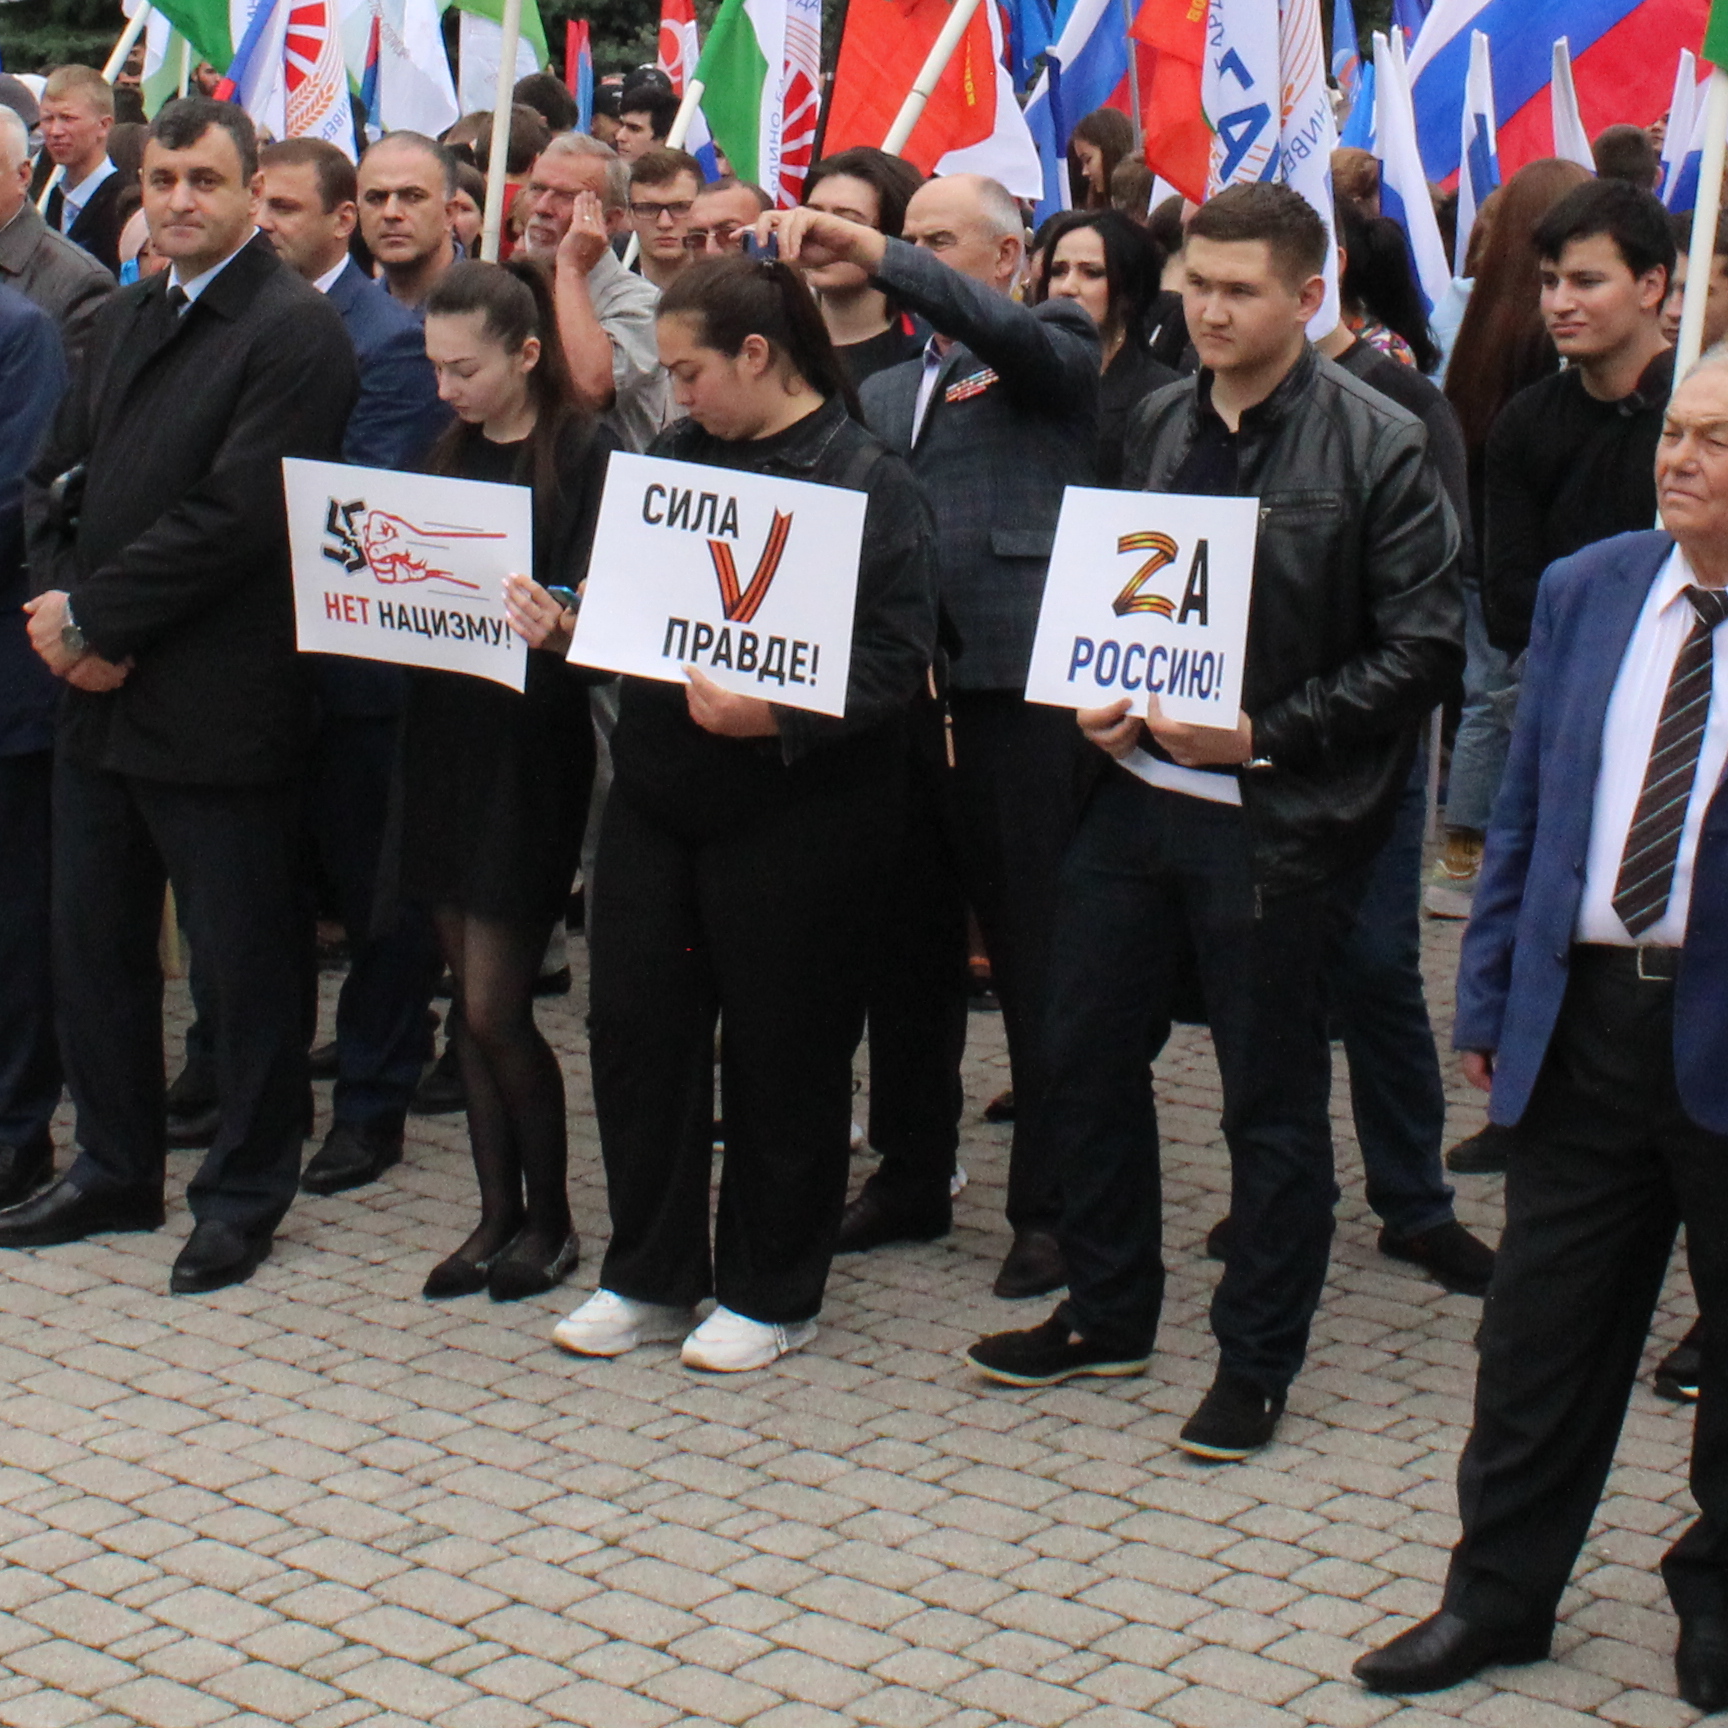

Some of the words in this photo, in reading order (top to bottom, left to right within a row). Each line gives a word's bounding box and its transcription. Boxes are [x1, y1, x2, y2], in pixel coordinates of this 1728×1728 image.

[642, 482, 740, 539] СИЛА
[323, 591, 370, 626] НЕТ
[377, 600, 513, 651] НАЦИЗМУ!
[661, 617, 820, 688] ПРАВДЕ!
[1066, 635, 1225, 702] РОССИЮ!
